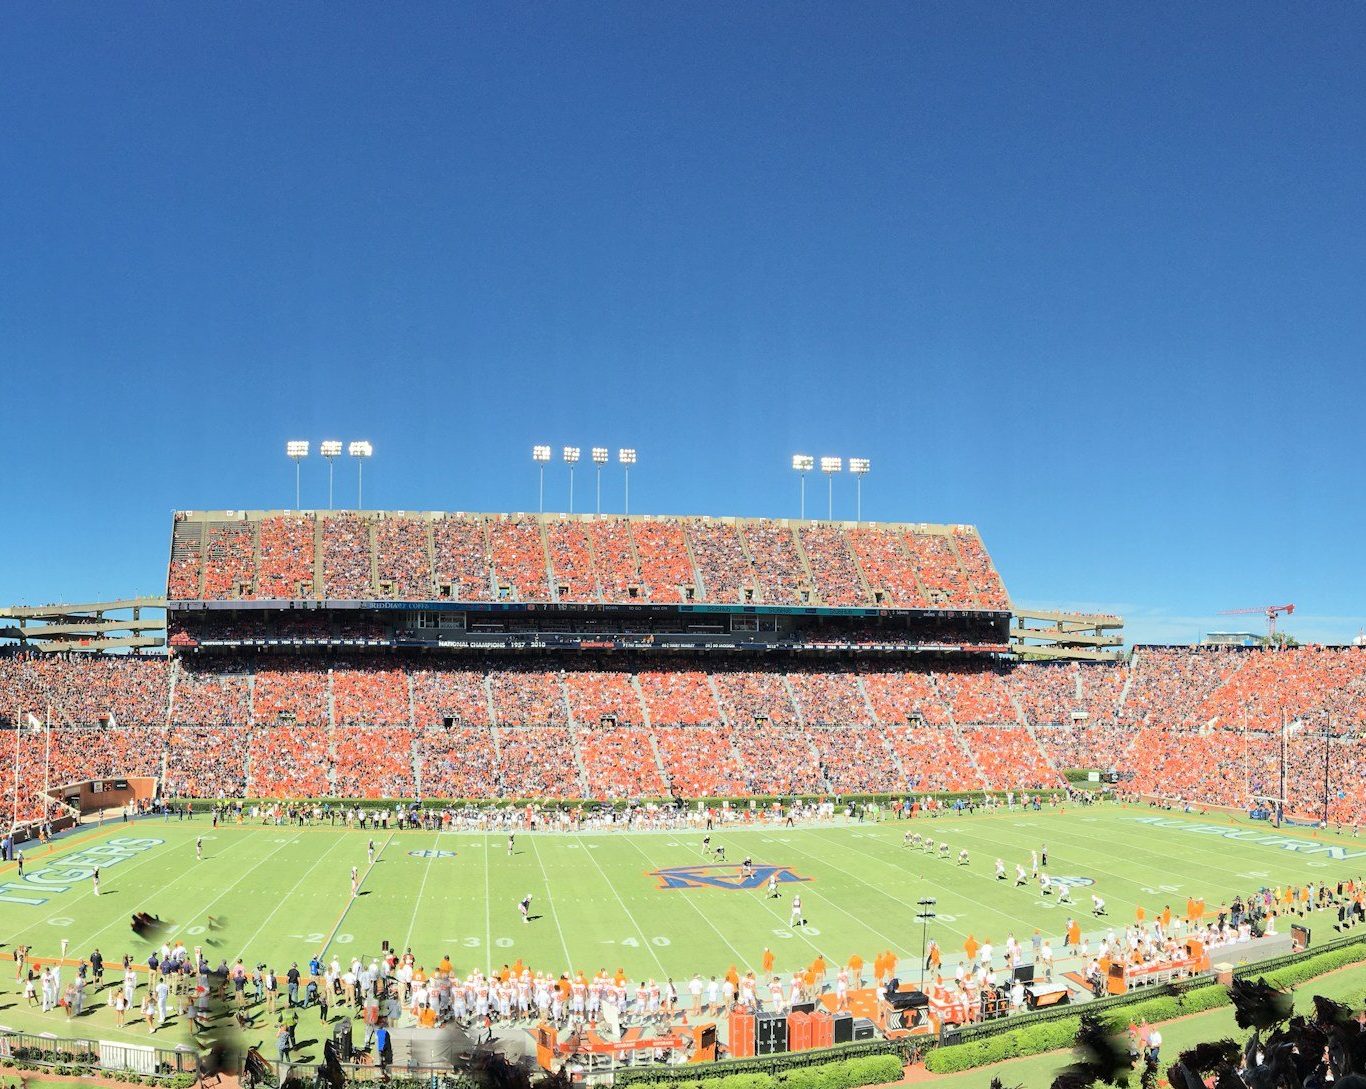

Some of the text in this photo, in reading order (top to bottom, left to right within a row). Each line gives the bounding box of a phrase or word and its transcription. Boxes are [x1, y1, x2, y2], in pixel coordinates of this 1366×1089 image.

[46, 916, 76, 927] G
[304, 933, 355, 944] 20
[771, 926, 822, 939] 50
[462, 936, 515, 948] 30
[619, 936, 672, 948] 40
